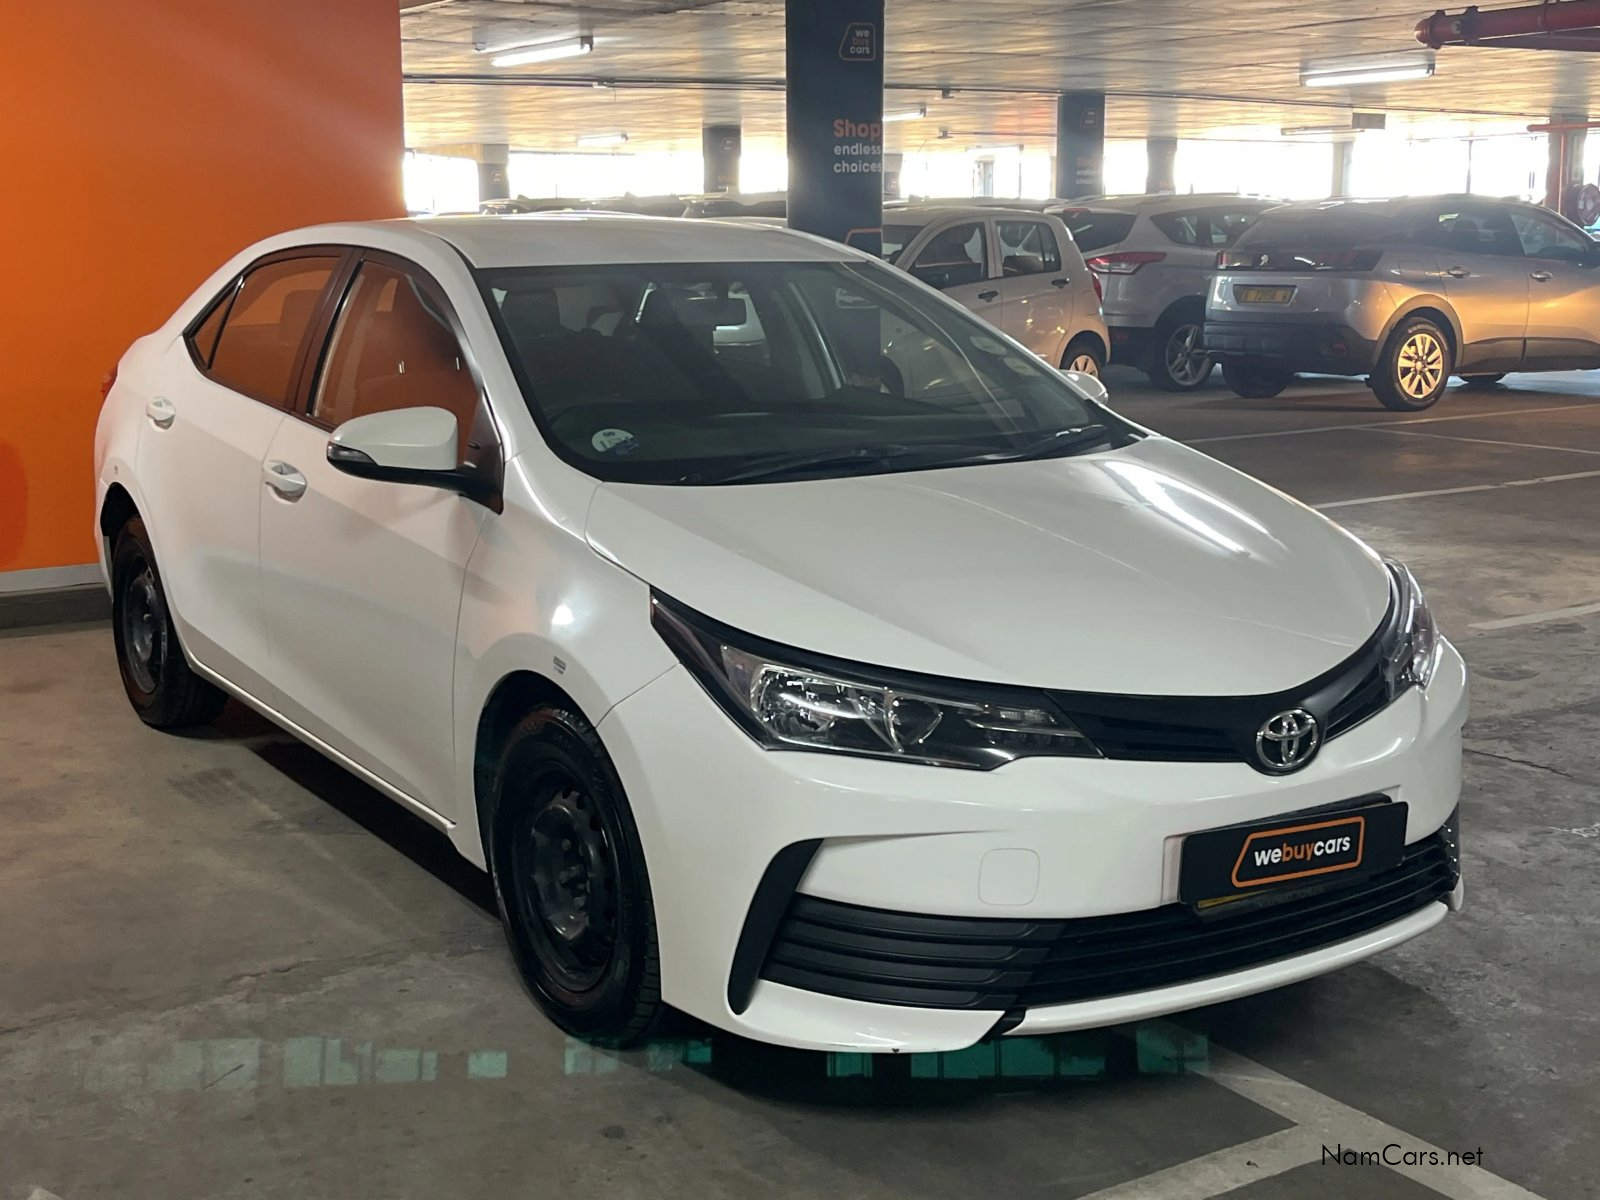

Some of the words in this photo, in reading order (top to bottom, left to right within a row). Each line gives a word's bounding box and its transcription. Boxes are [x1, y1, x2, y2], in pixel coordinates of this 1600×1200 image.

[855, 30, 870, 38] we
[850, 46, 870, 54] cars
[833, 119, 881, 142] Shop
[834, 143, 881, 155] endless
[1254, 836, 1351, 867] webuycars
